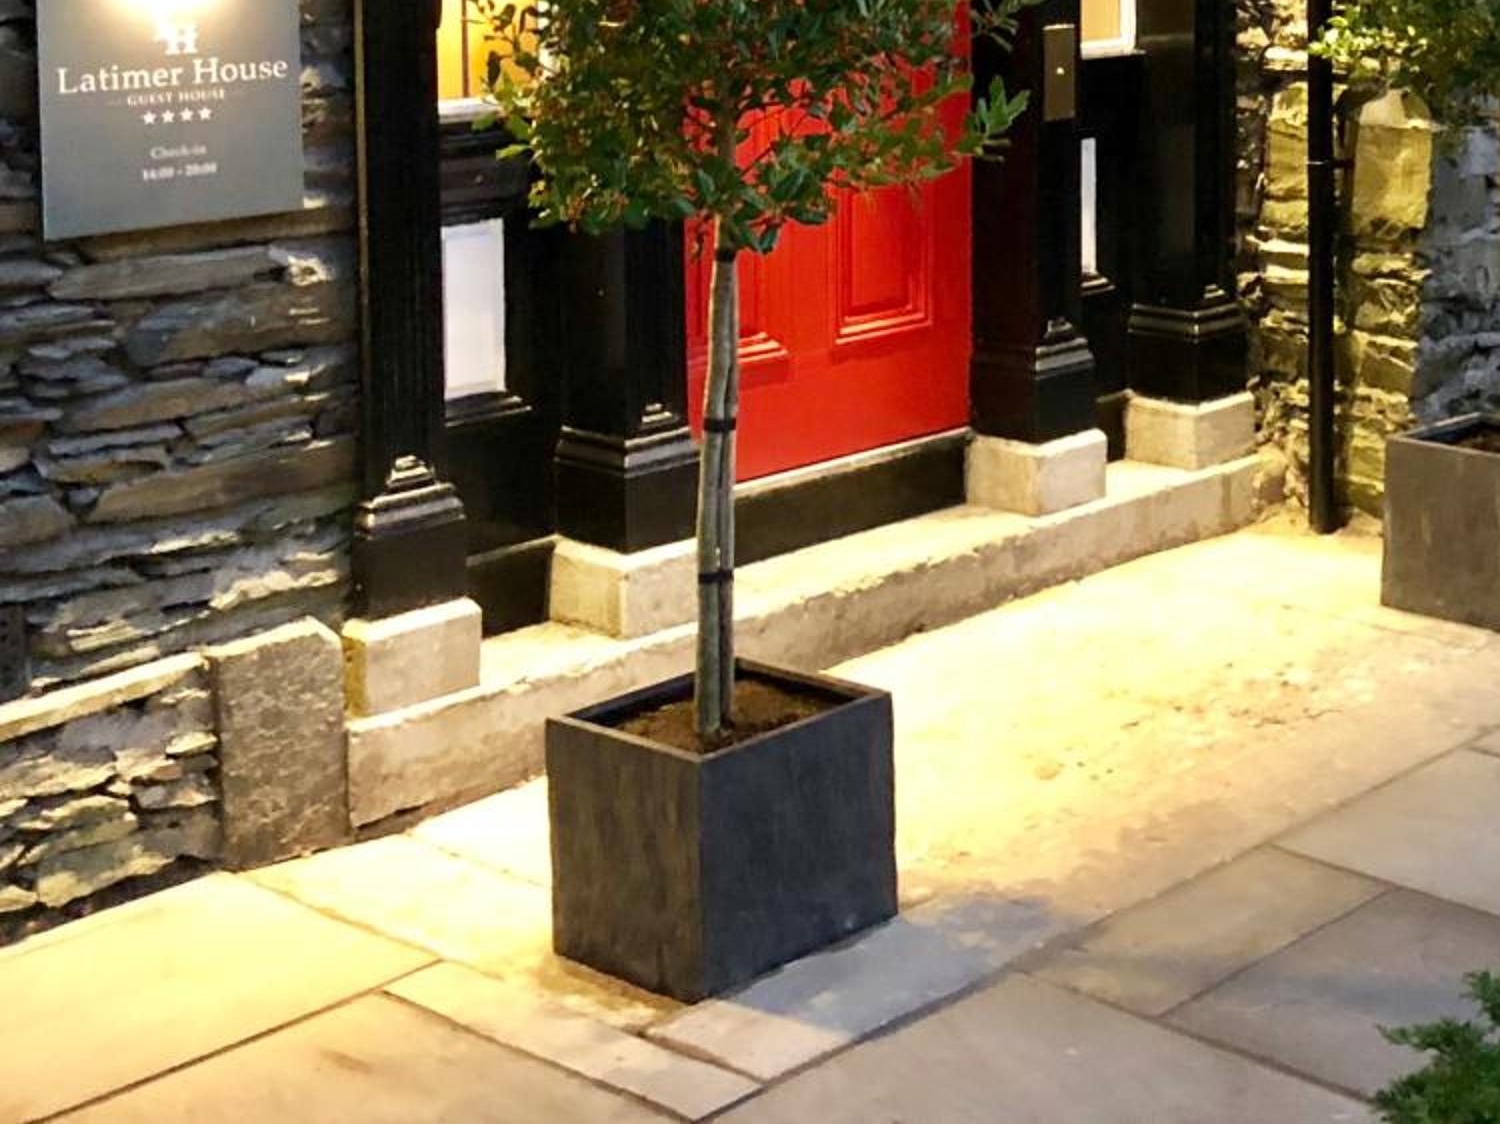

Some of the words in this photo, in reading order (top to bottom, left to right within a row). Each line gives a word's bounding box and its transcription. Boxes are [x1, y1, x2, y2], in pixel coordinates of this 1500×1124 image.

[56, 65, 183, 94] Latimer
[192, 56, 289, 84] House
[127, 91, 173, 106] GUEST
[179, 89, 226, 102] HOUSE
